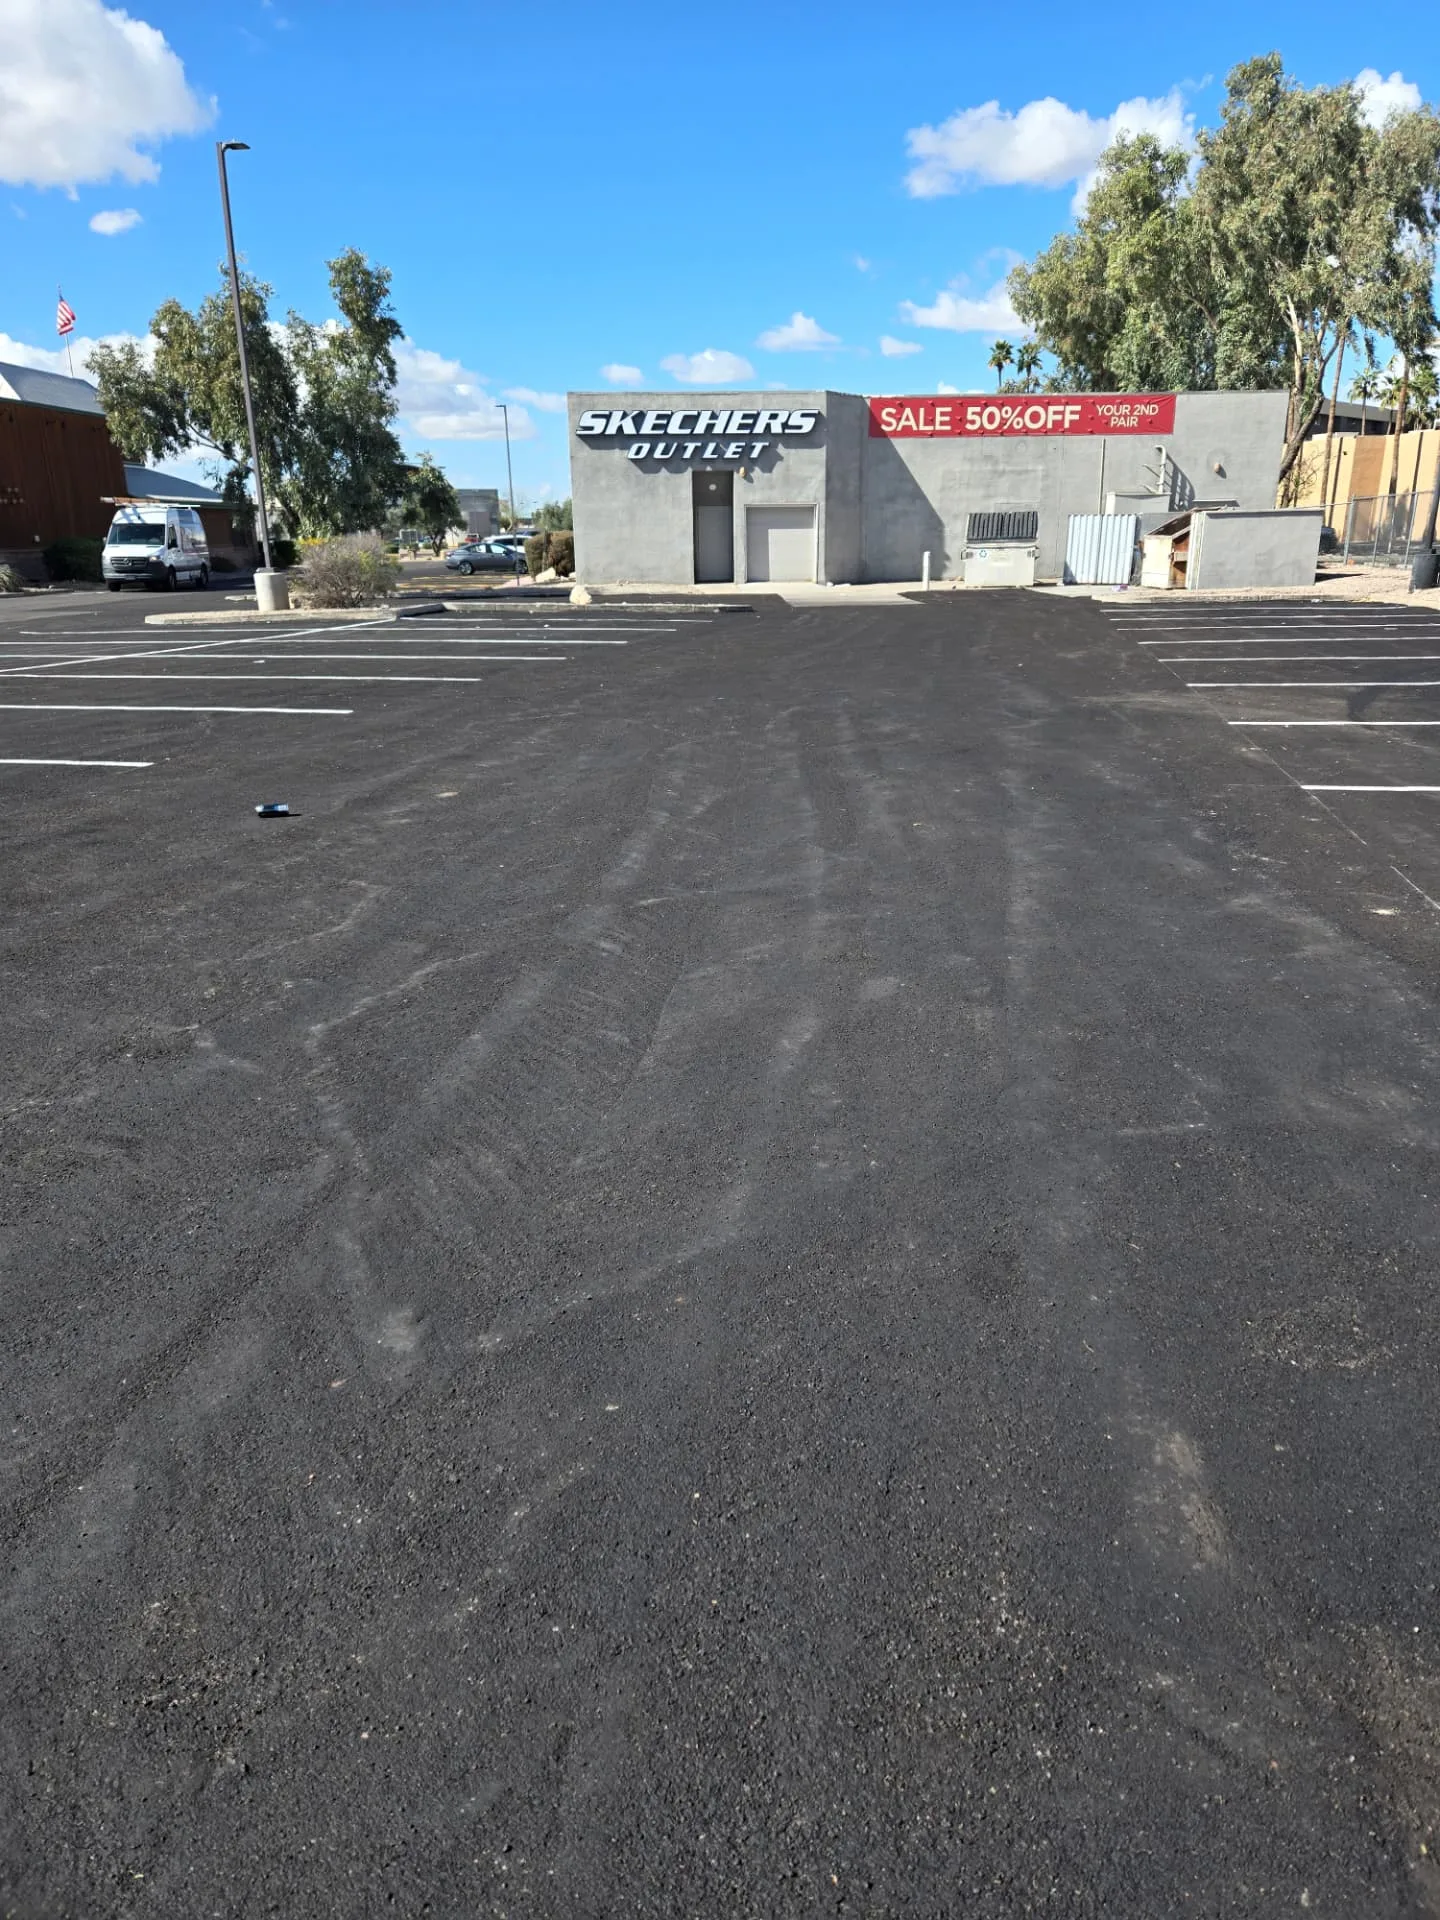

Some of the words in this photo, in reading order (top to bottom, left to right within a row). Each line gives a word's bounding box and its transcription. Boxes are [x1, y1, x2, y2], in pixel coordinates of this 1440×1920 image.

[1097, 404, 1131, 415] YOUR
[1133, 404, 1158, 415] 2ND
[576, 410, 820, 435] SKECHERS
[881, 407, 952, 431] SALE
[1111, 416, 1138, 428] PAIR
[627, 442, 769, 458] OUTLET
